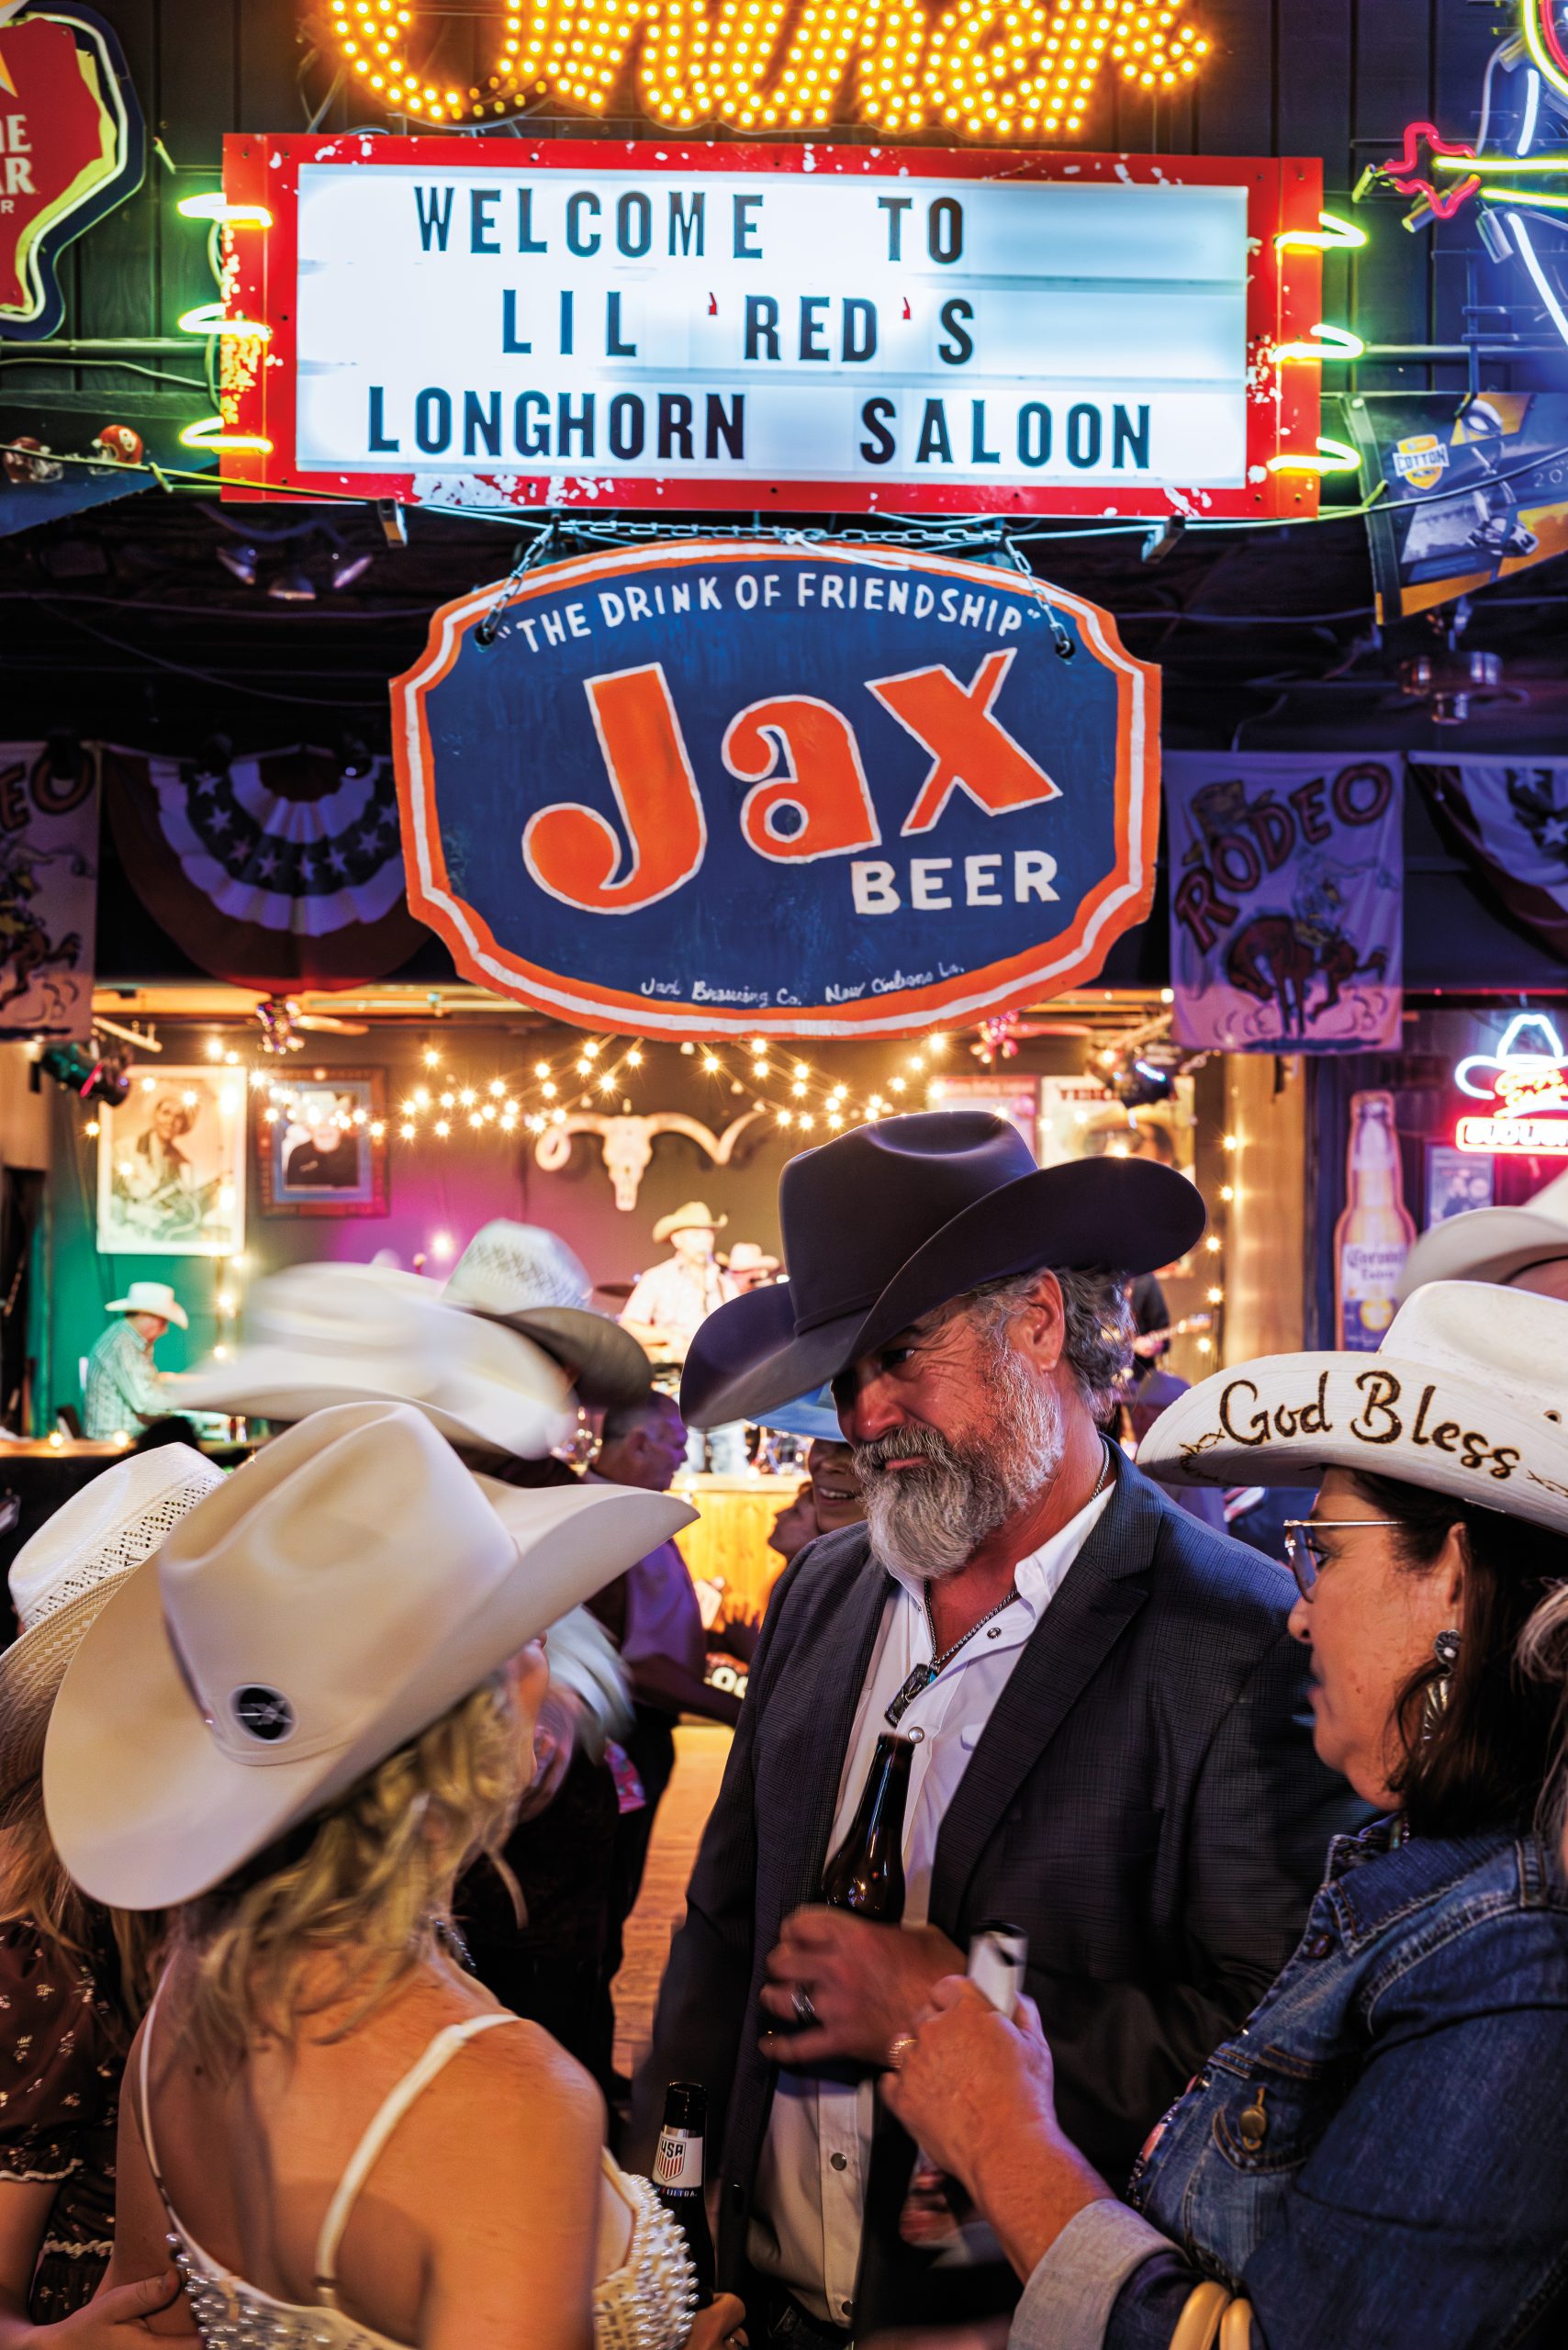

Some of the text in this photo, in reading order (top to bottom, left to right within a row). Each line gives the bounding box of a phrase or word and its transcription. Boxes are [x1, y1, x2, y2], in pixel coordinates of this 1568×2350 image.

[413, 186, 964, 264] WELCOME TO
[502, 289, 637, 358] LIL
[368, 386, 1151, 470] LONGHORN SALOON
[1395, 446, 1448, 473] COTTON
[598, 576, 722, 628] DRINK
[735, 574, 782, 610] OF
[521, 646, 1064, 915] Jax
[850, 849, 1060, 916] BEER
[1173, 760, 1394, 956] RODEO
[776, 987, 802, 1007] Co.
[824, 981, 866, 1002] New
[1218, 1370, 1521, 1480] God Bless
[660, 2140, 684, 2158] USA
